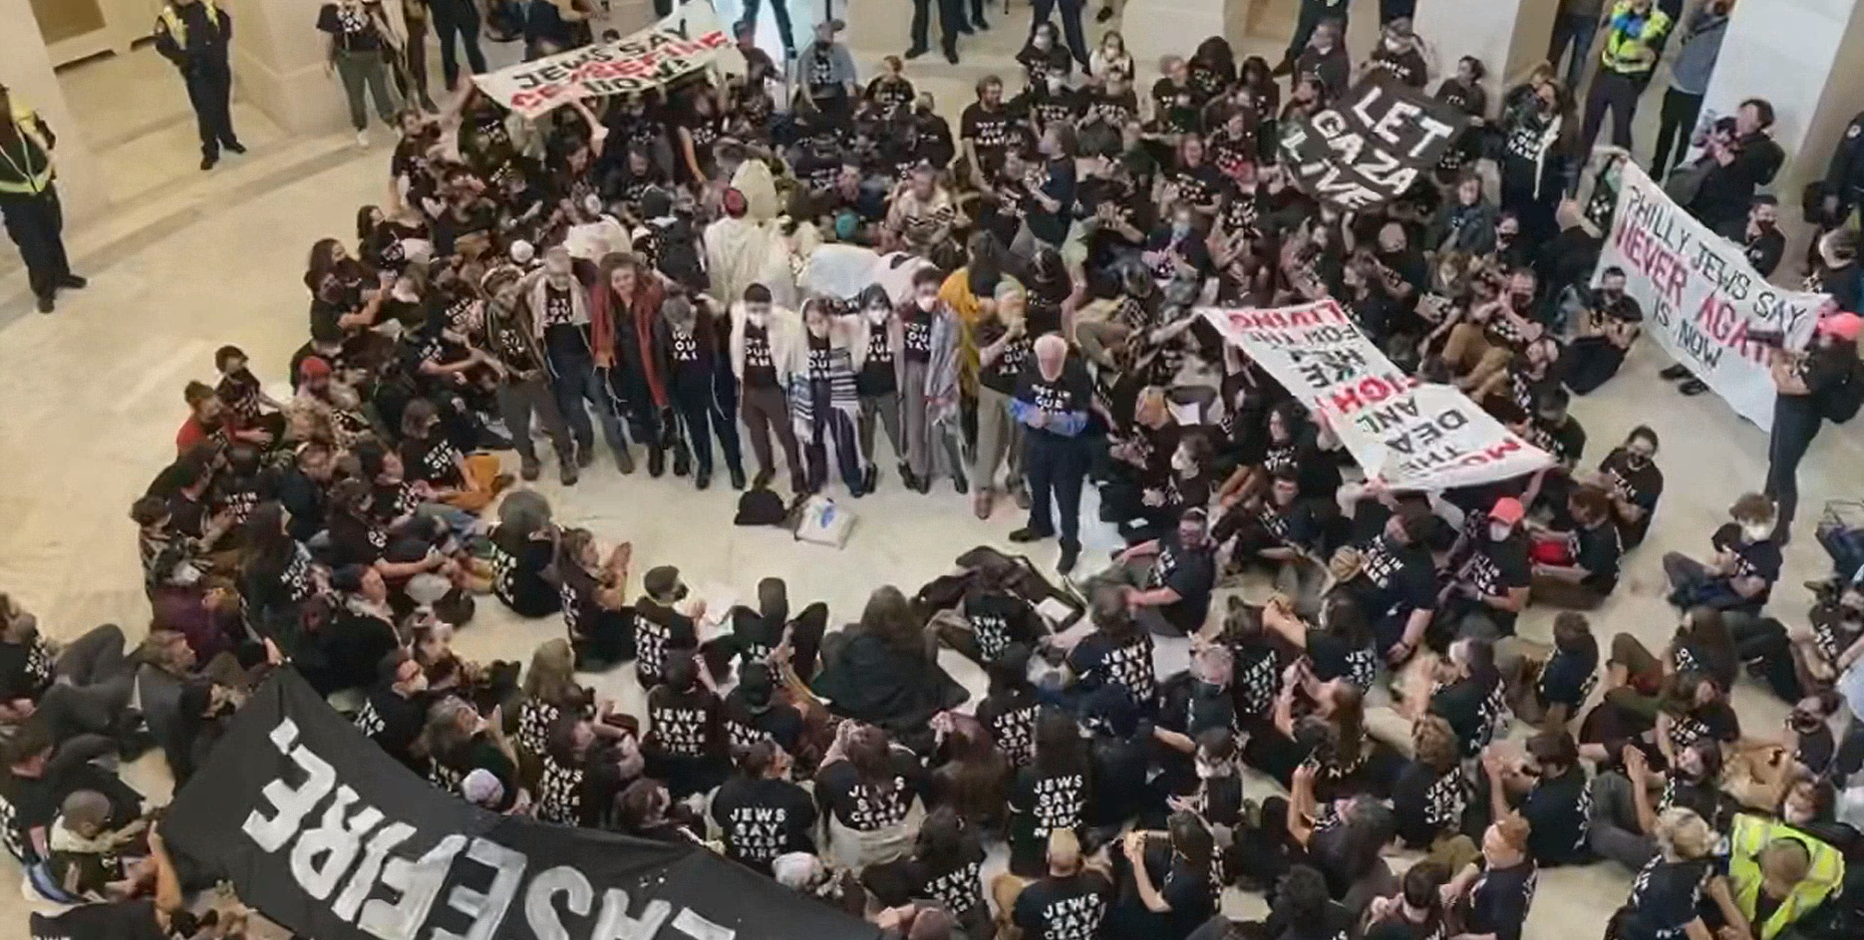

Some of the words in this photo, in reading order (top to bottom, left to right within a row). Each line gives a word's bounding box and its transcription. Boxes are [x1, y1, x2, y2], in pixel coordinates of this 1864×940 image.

[513, 47, 614, 89] JEWS
[618, 18, 687, 55] SAY
[1353, 86, 1454, 157] LET
[1311, 109, 1418, 194] GAZA
[1614, 217, 1689, 310] NEVER
[1628, 185, 1691, 252] PHILLY
[1690, 241, 1751, 300] JEWS
[1753, 291, 1806, 332] SAY
[908, 332, 929, 343] OU
[1654, 299, 1671, 328] IS
[1675, 317, 1724, 370] NOW
[654, 708, 706, 722] JEWS
[659, 721, 698, 734] SAY
[724, 719, 774, 742] JEWS
[1033, 774, 1083, 795] JEWS
[1039, 789, 1077, 807] SAY
[730, 807, 787, 822] JEWS
[736, 822, 778, 837] SAY
[924, 861, 979, 894] JEWS
[1043, 892, 1099, 919] JEWS
[1051, 907, 1094, 931] SAY
